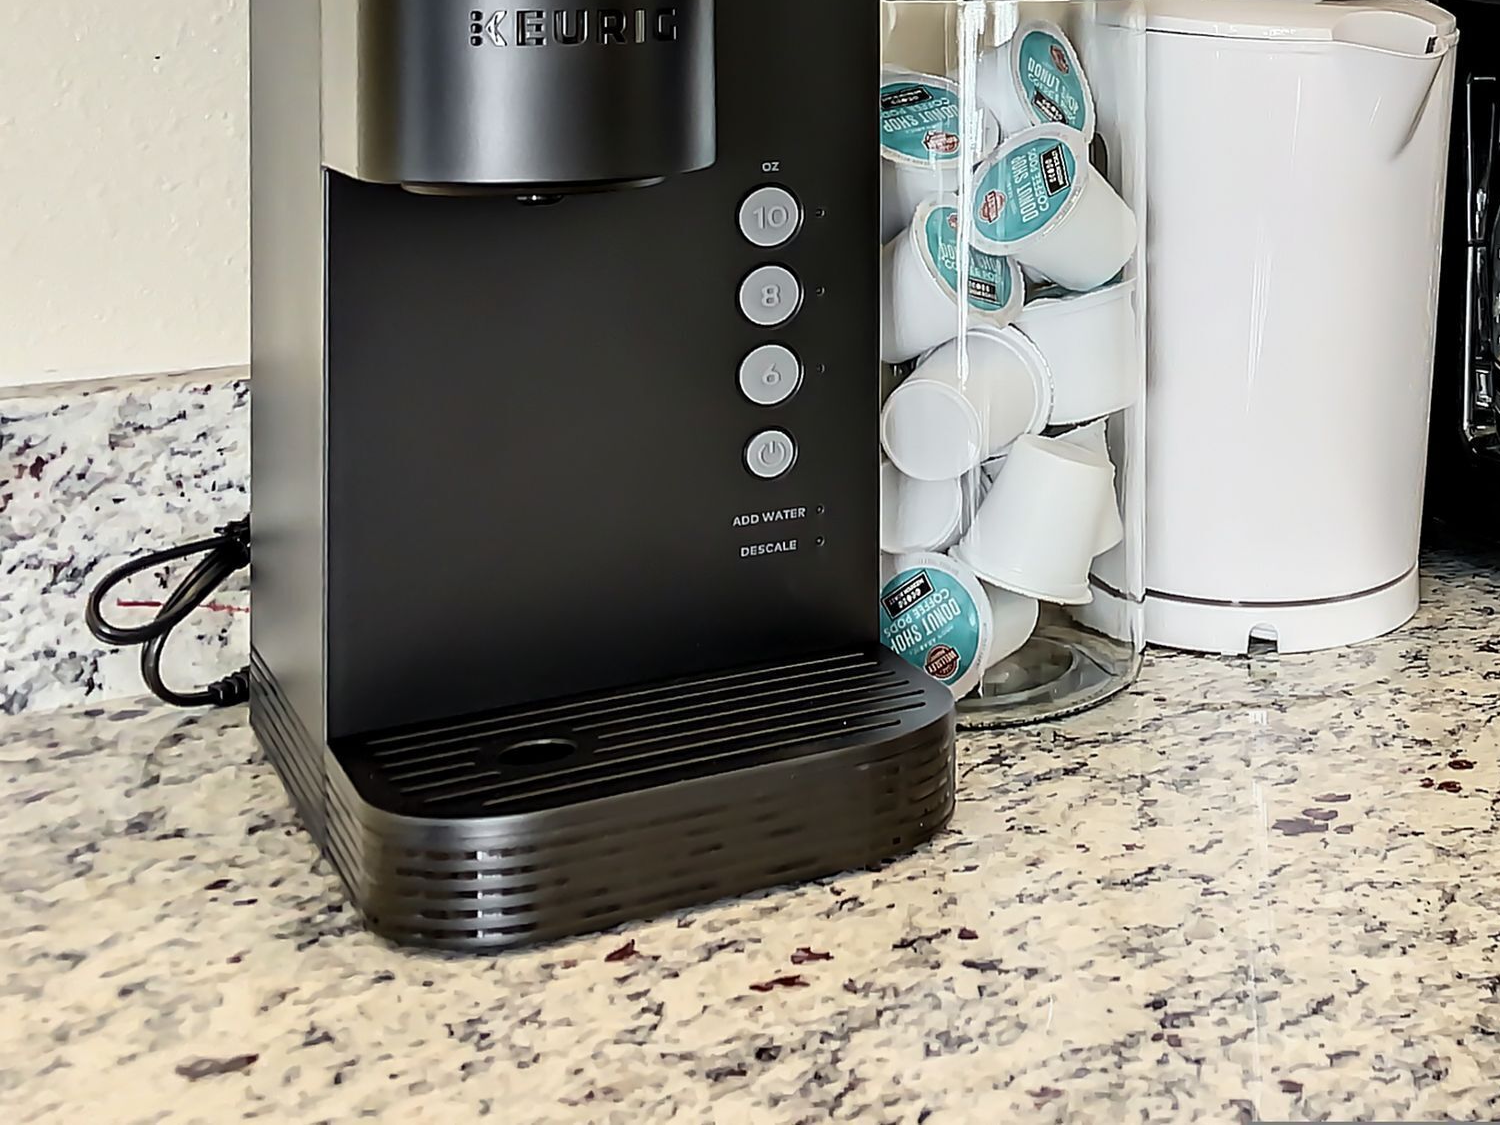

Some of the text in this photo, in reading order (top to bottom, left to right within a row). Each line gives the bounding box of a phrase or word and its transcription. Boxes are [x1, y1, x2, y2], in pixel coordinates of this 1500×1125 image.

[470, 10, 677, 46] KEURIG
[1027, 57, 1061, 92] DONUT
[883, 114, 919, 133] SHOP
[1011, 154, 1040, 223] DONUT SHOP
[1032, 172, 1050, 212] COFFEE
[753, 205, 789, 229] 10
[761, 284, 781, 307] 8
[761, 362, 781, 385] 6
[732, 507, 806, 527] ADD WATER
[740, 539, 797, 557] DESCALE
[912, 587, 950, 620] COFFEE
[883, 613, 913, 638] PODS
[921, 597, 962, 636] DONUT
